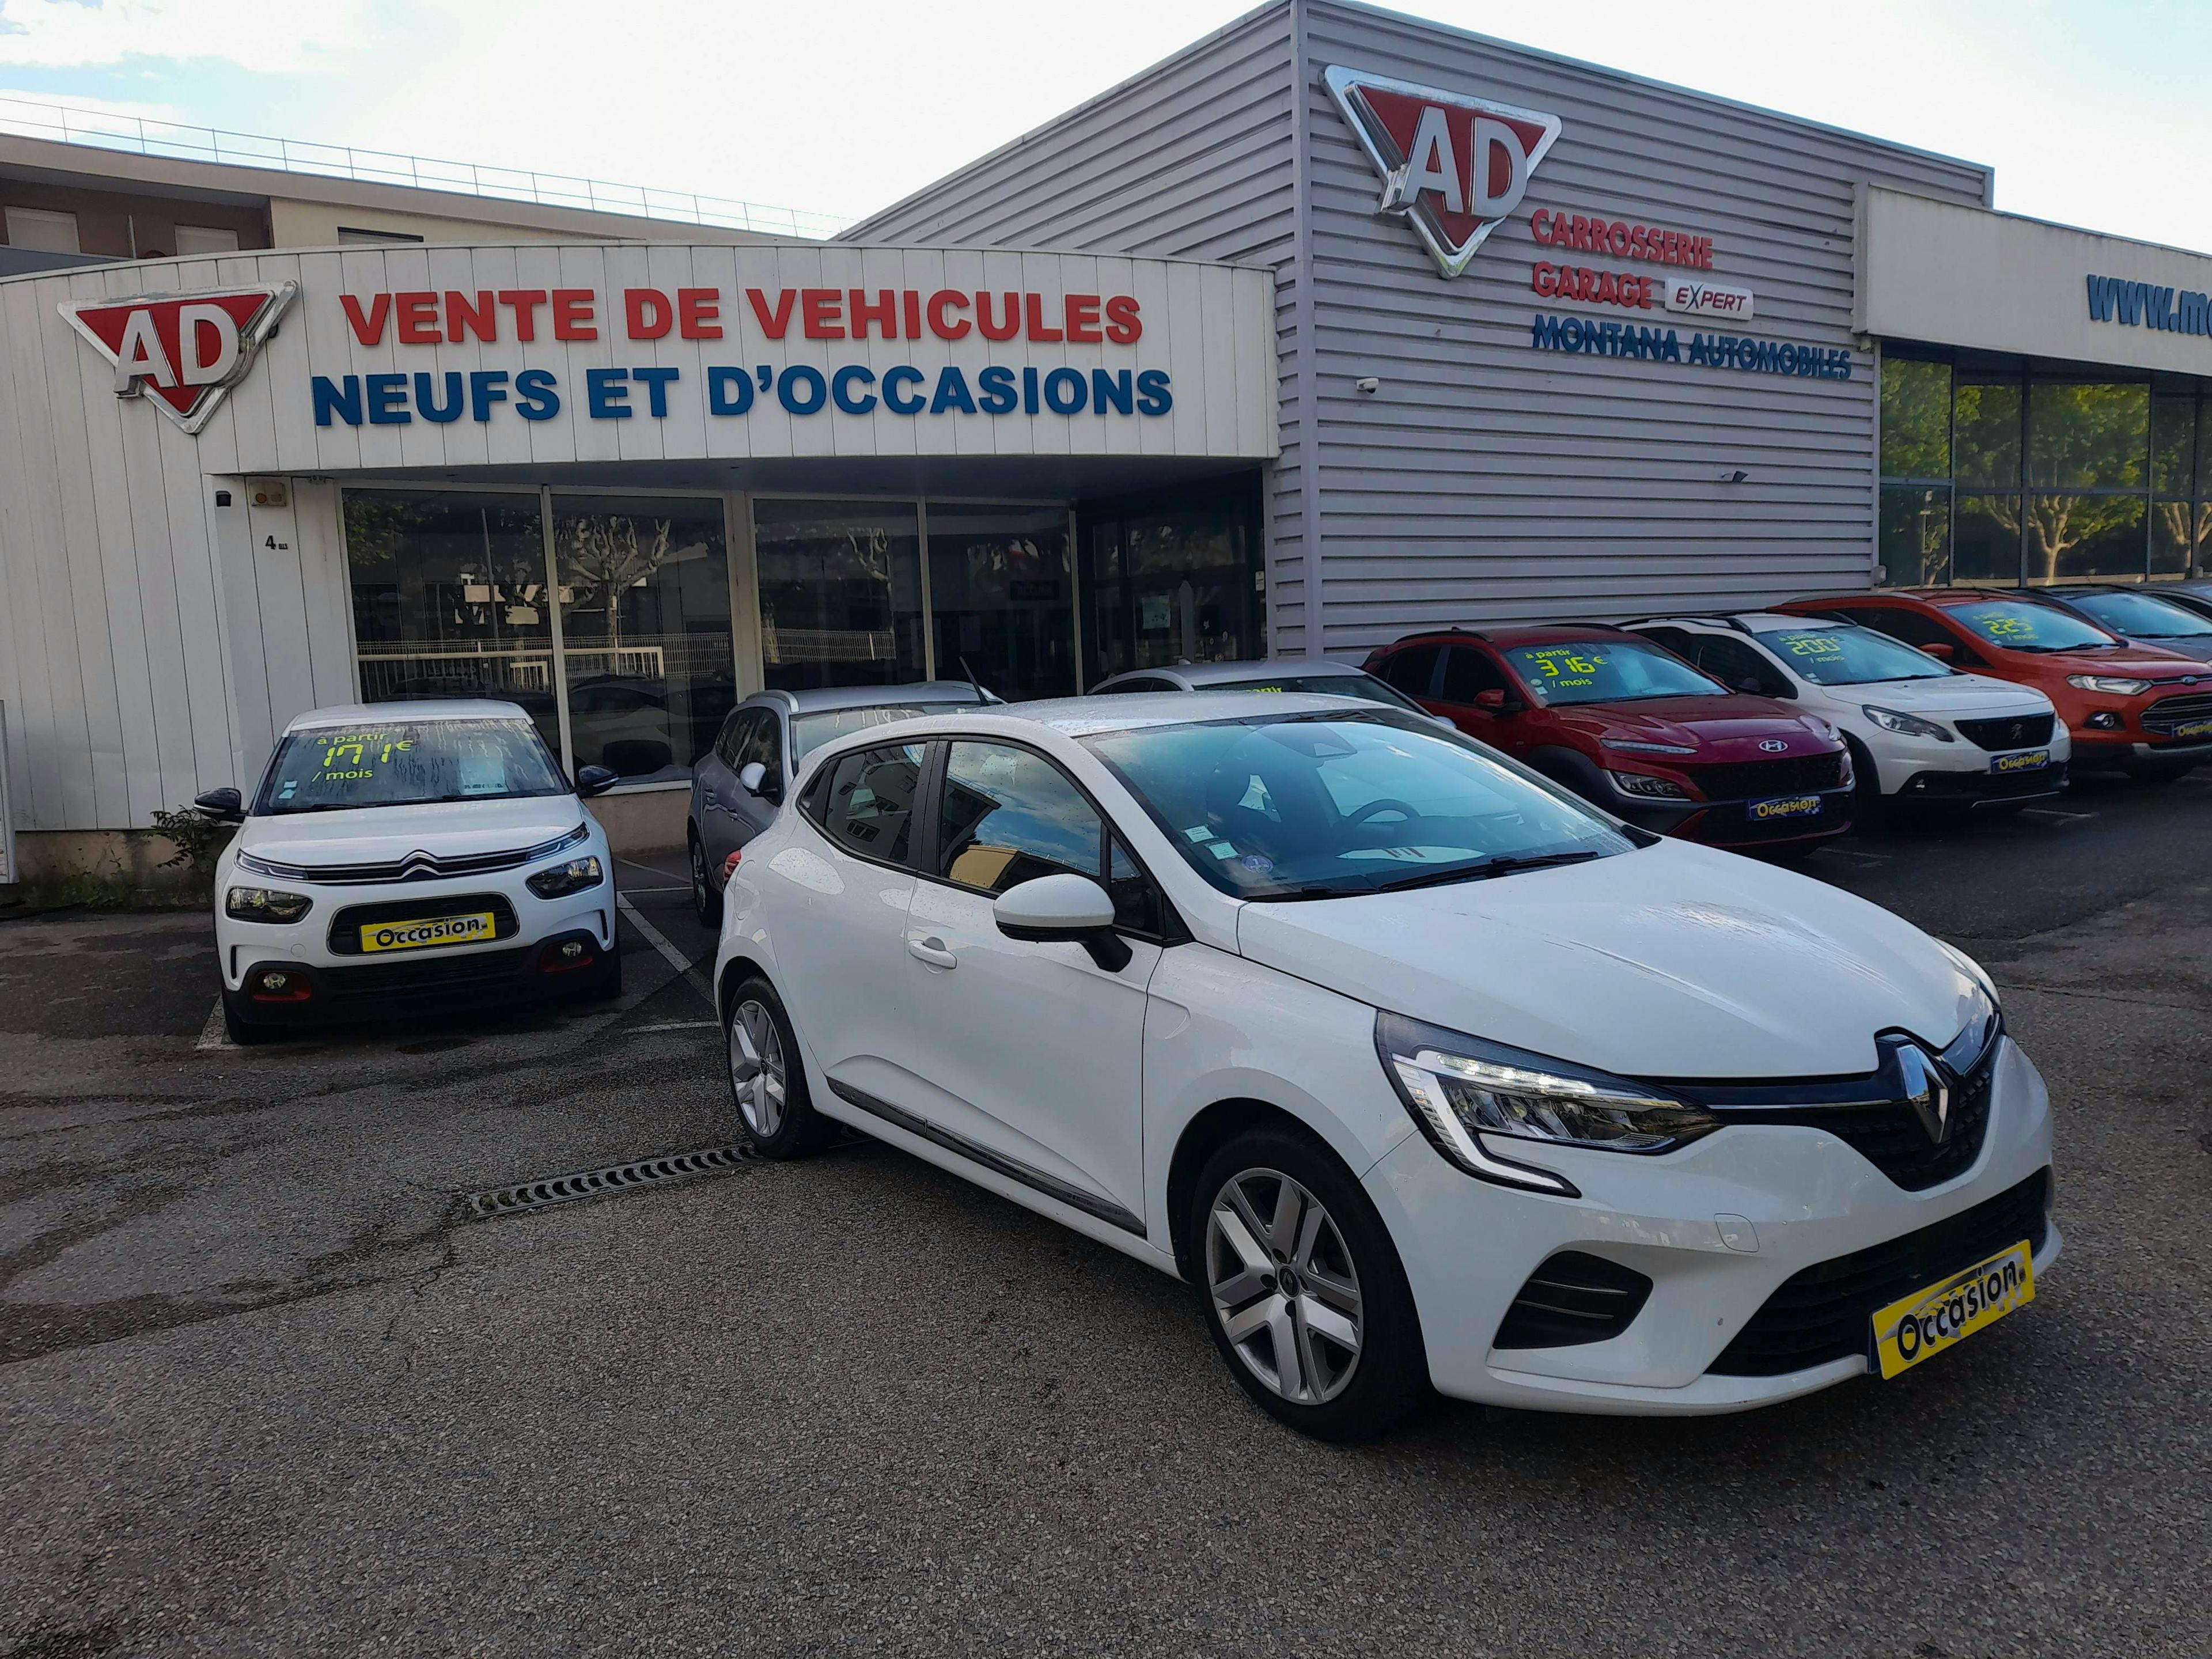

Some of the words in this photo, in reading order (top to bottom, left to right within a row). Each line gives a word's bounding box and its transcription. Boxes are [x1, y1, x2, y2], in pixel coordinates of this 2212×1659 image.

[1382, 105, 1528, 218] AD
[1532, 208, 1713, 270] CARROSSERIE
[1533, 260, 1653, 309] GARAGE
[2087, 274, 2212, 340] www.m
[339, 289, 598, 345] VENTE
[624, 288, 724, 340] DE
[745, 288, 1143, 344] VEHICULES
[114, 304, 242, 397] AD
[1533, 314, 1681, 363] MONTANA
[1688, 333, 1853, 380] AUTOMOBILES
[311, 369, 560, 426] NEUFS
[586, 368, 679, 419] ET
[266, 535, 276, 550] 4
[1535, 649, 1571, 659] partir
[1559, 677, 1593, 687] mois
[334, 732, 388, 745] partir
[325, 768, 373, 781] mois
[1757, 796, 1817, 818] Occasion
[376, 918, 480, 947] Occasion
[1896, 1259, 2019, 1362] Occasion
